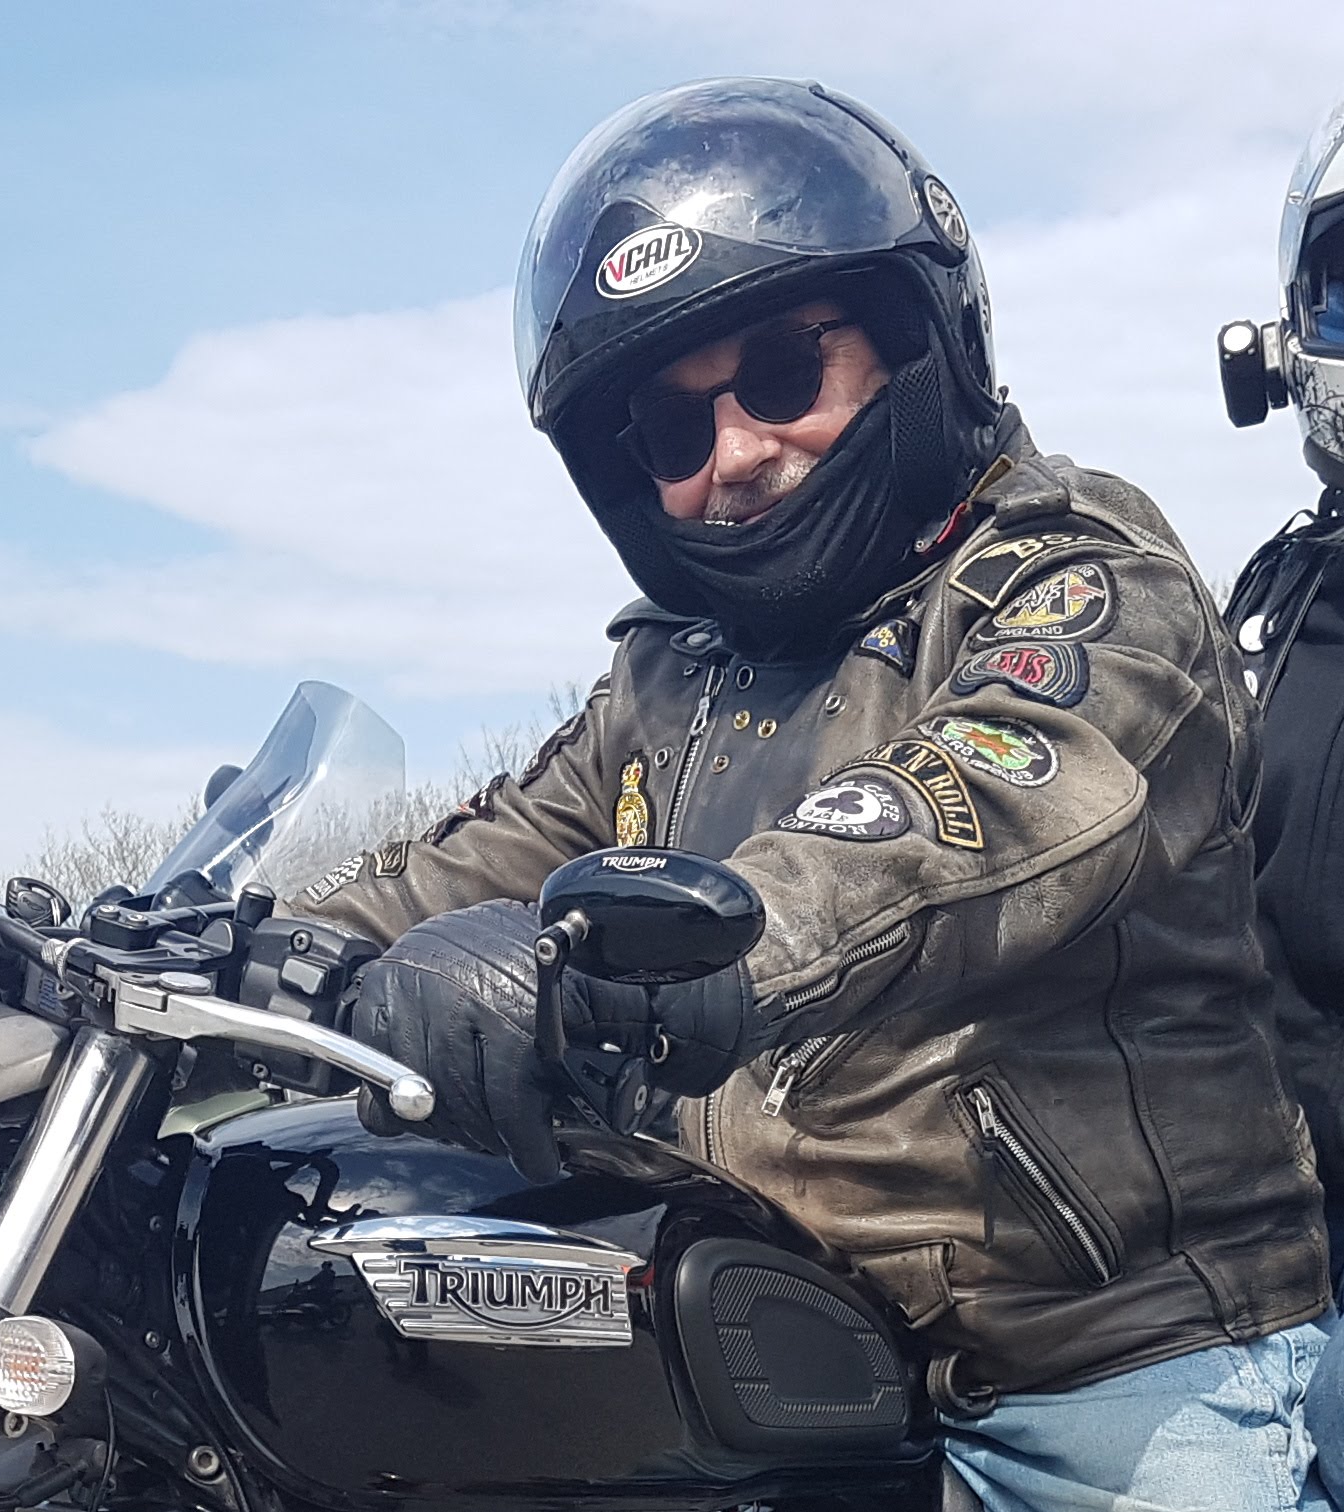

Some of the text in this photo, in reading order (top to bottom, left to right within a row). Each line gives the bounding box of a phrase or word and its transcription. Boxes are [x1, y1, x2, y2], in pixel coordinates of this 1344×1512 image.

[994, 625, 1063, 638] ENGLAND
[922, 771, 974, 834] ROLL
[601, 856, 668, 872] TRIUMPH
[400, 1260, 613, 1329] TRIUMPH
